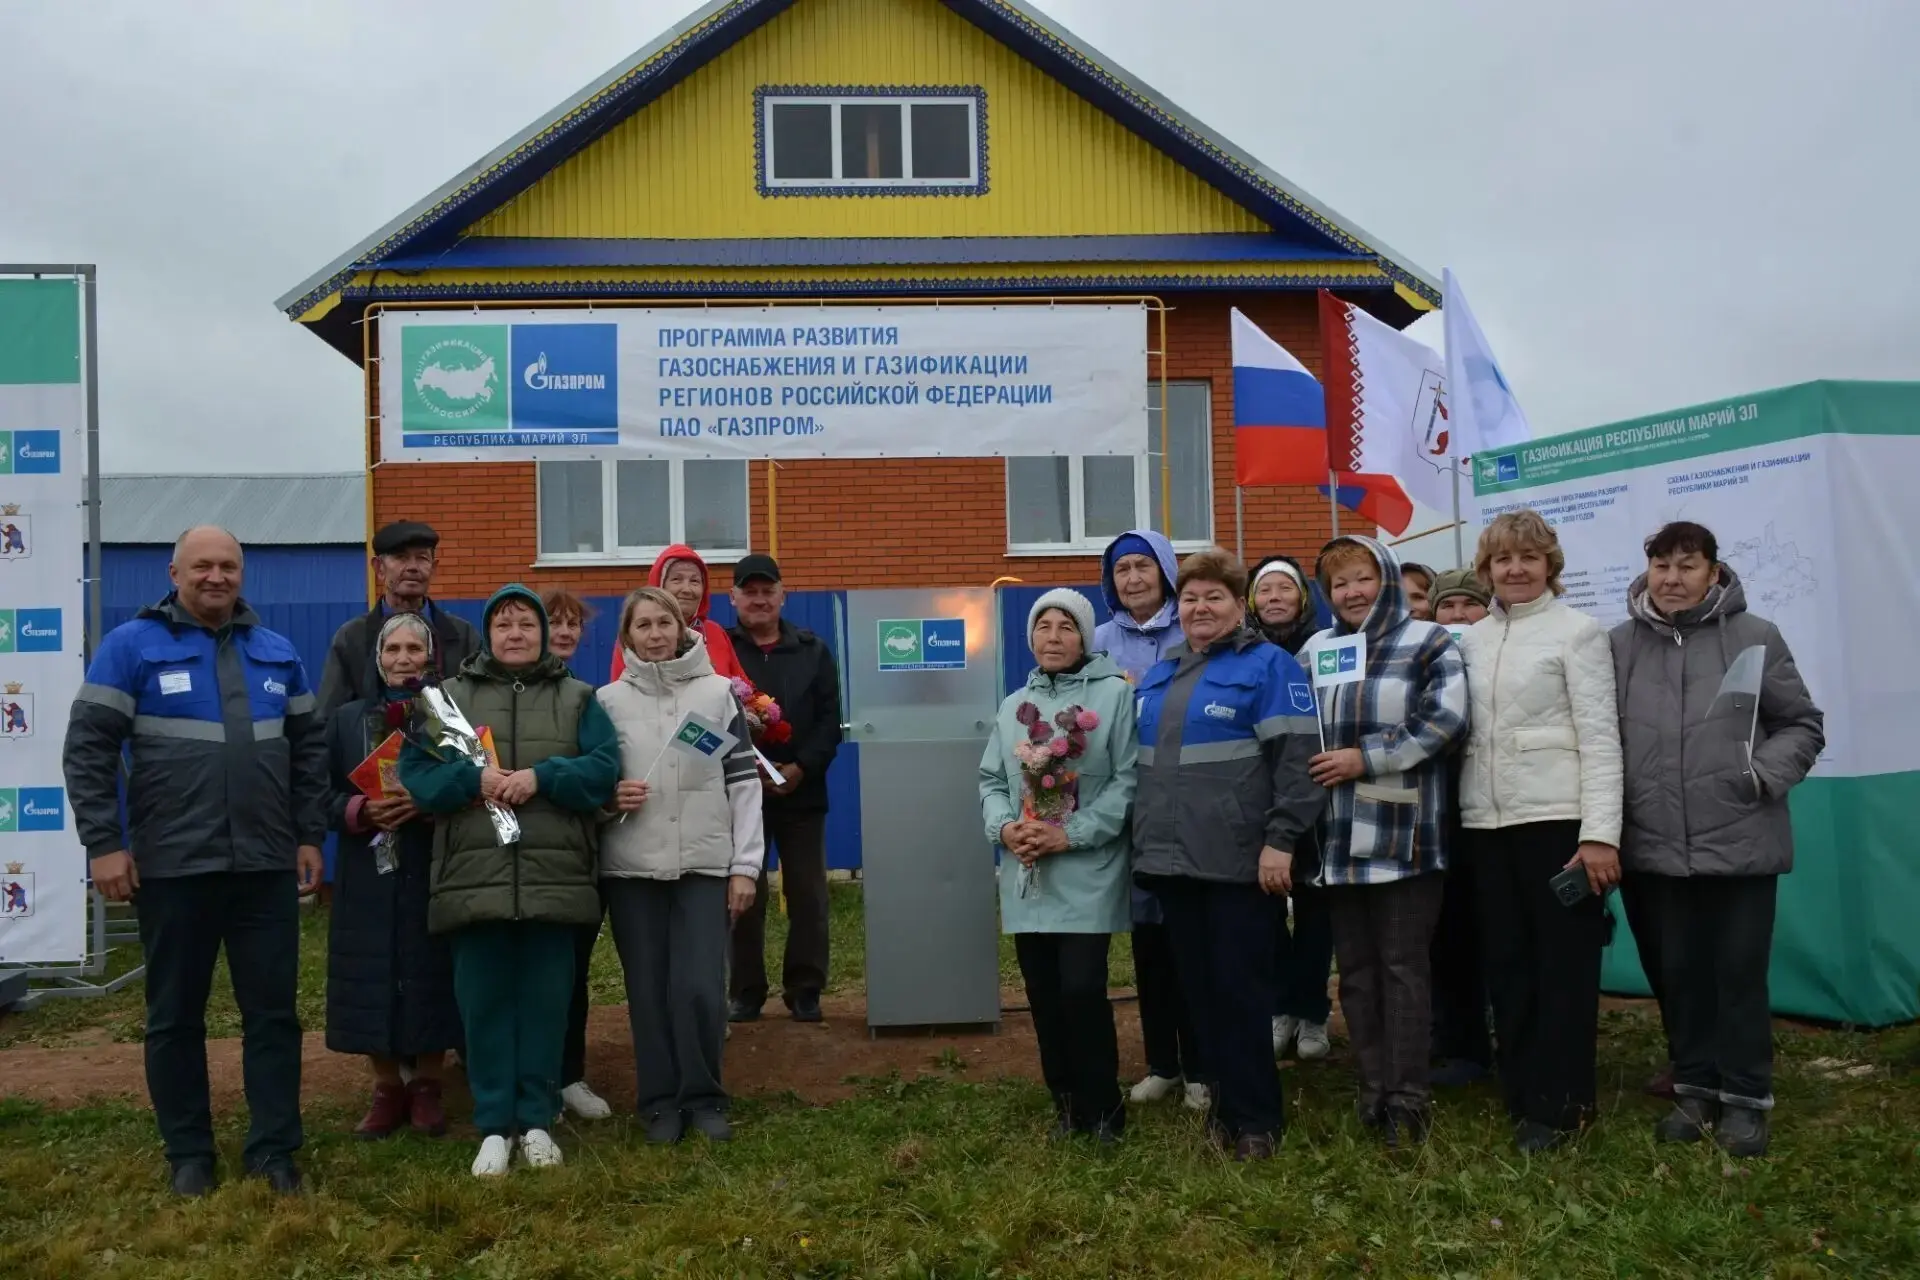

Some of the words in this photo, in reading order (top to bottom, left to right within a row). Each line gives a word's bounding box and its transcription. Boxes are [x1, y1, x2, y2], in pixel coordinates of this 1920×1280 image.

[658, 327, 787, 347] ПРОГРАММА
[792, 326, 899, 347] РАЗВИТИЯ
[658, 356, 836, 377] ГАЗОСНАБЖЕНИЯ
[842, 356, 856, 375] И
[864, 355, 1028, 378] ГАЗИФИКАЦИИ
[547, 375, 606, 390] ГАЗПРОМ
[659, 386, 773, 407] РЕГИОНОВ
[781, 380, 919, 406] РОССИЙСКОЙ
[925, 384, 1052, 407] ФЕДЕРАЦИИ
[659, 417, 701, 437] ПАО
[707, 416, 825, 436] «ГАЗПРОМ»
[1523, 436, 1603, 464] ГАЗИФИКАЦИЯ
[1606, 418, 1686, 447] РЕСПУБЛИКИ
[1688, 404, 1736, 431] МАРИЙ
[1739, 403, 1758, 421] ЭЛ
[433, 433, 515, 446] РЕСПУБЛИКА
[521, 432, 565, 444] МАРИЙ
[571, 433, 589, 443] ЭЛ
[1690, 463, 1750, 480] ГАЗОСНАБЖЕНИЯ
[1750, 461, 1757, 471] И
[1757, 452, 1811, 469] ГАЗИФИКАЦИИ
[1668, 482, 1712, 496] РЕСПУБЛИКИ
[1713, 476, 1738, 489] МАРИЙ
